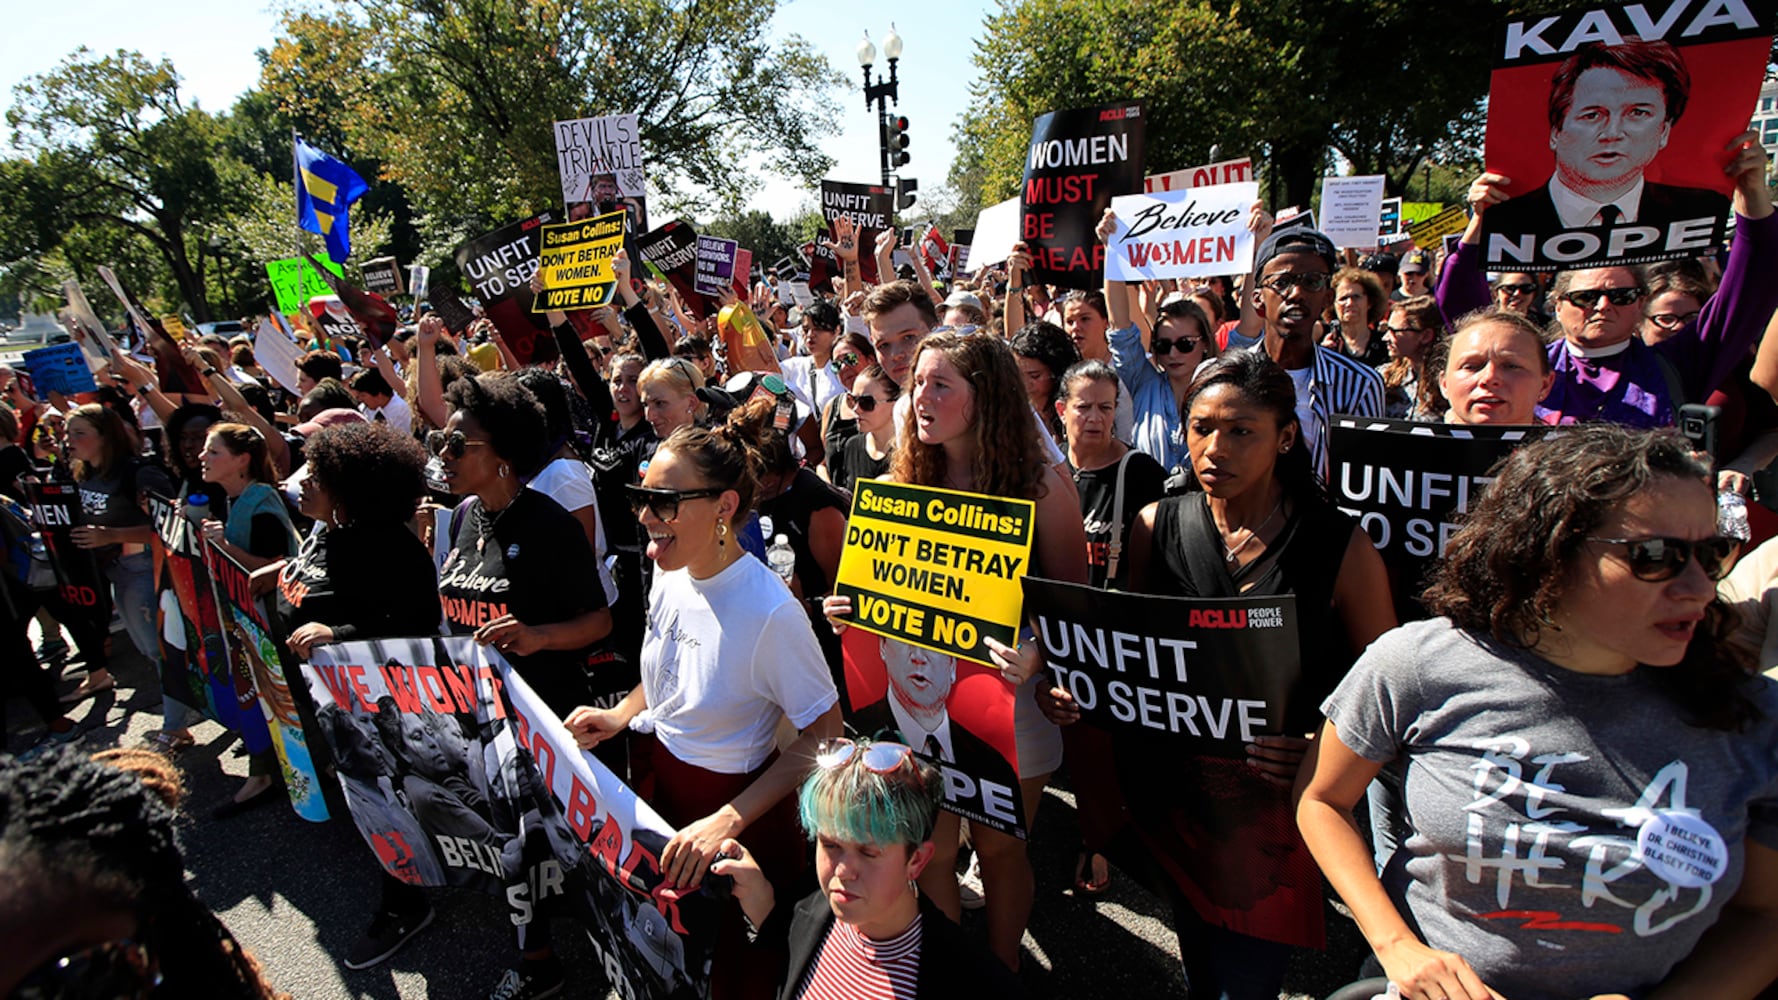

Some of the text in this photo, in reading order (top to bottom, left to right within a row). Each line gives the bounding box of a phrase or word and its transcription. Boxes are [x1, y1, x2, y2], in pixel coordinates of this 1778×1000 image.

[1504, 0, 1759, 59] KAVA
[560, 117, 631, 149] DEVIL'S
[560, 141, 641, 175] TRIANGLE
[1031, 133, 1128, 169] WOMEN
[824, 191, 871, 210] UNFIT
[1026, 174, 1098, 205] MUST
[824, 207, 840, 222] TO
[1024, 213, 1055, 239] BE
[1119, 200, 1241, 244] Believe
[546, 229, 580, 245] Susan
[582, 220, 621, 239] Collins:
[642, 235, 678, 260] UNFIT
[1487, 216, 1717, 264] NOPE
[466, 236, 533, 280] UNFIT
[541, 242, 621, 268] DON'T BETRAY
[1026, 245, 1105, 272] HEAR
[476, 256, 540, 300] TO SER
[556, 265, 602, 282] WOMEN.
[547, 286, 604, 306] VOTE NO
[323, 323, 361, 335] NOP
[29, 504, 72, 525] MEN
[859, 489, 1023, 537] Susan Collins:
[847, 525, 1023, 581] DON'T BETRAY
[439, 559, 510, 592] Believe
[872, 558, 972, 603] WOMEN.
[858, 594, 978, 650] VOTE NO
[1188, 607, 1282, 629] ACLU PEOPLE
[1248, 616, 1284, 628] POWER
[1038, 615, 1198, 683] UNFIT
[315, 665, 380, 713] WE
[379, 664, 507, 720] WONT
[1046, 660, 1267, 743] TO SERVE
[941, 765, 1018, 825] PE
[1461, 736, 1701, 828] BE A
[1664, 823, 1711, 849] I BELIEVE
[435, 834, 506, 880] BELI
[1643, 846, 1713, 881] BLASEY FORD
[1666, 839, 1719, 868] CHRISTINE
